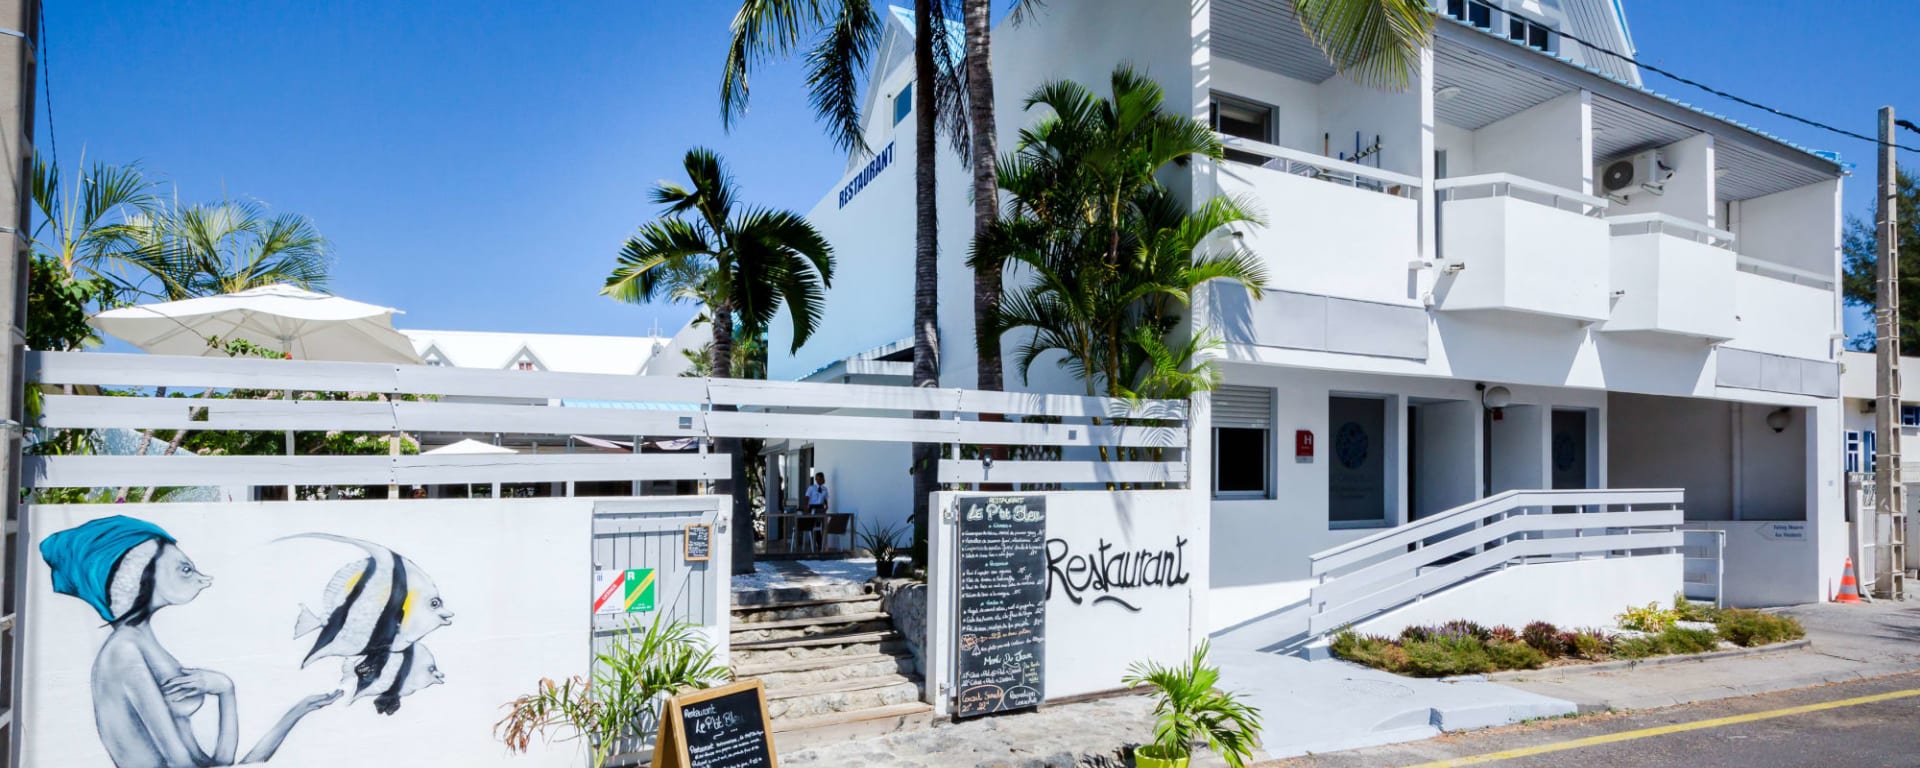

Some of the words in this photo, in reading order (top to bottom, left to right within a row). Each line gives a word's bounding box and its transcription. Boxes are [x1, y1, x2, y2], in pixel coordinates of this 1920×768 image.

[839, 140, 894, 210] RESTAURANT
[1304, 434, 1312, 445] H
[627, 571, 636, 581] R
[1045, 535, 1190, 605] Restaurant
[683, 703, 717, 718] Restaurant
